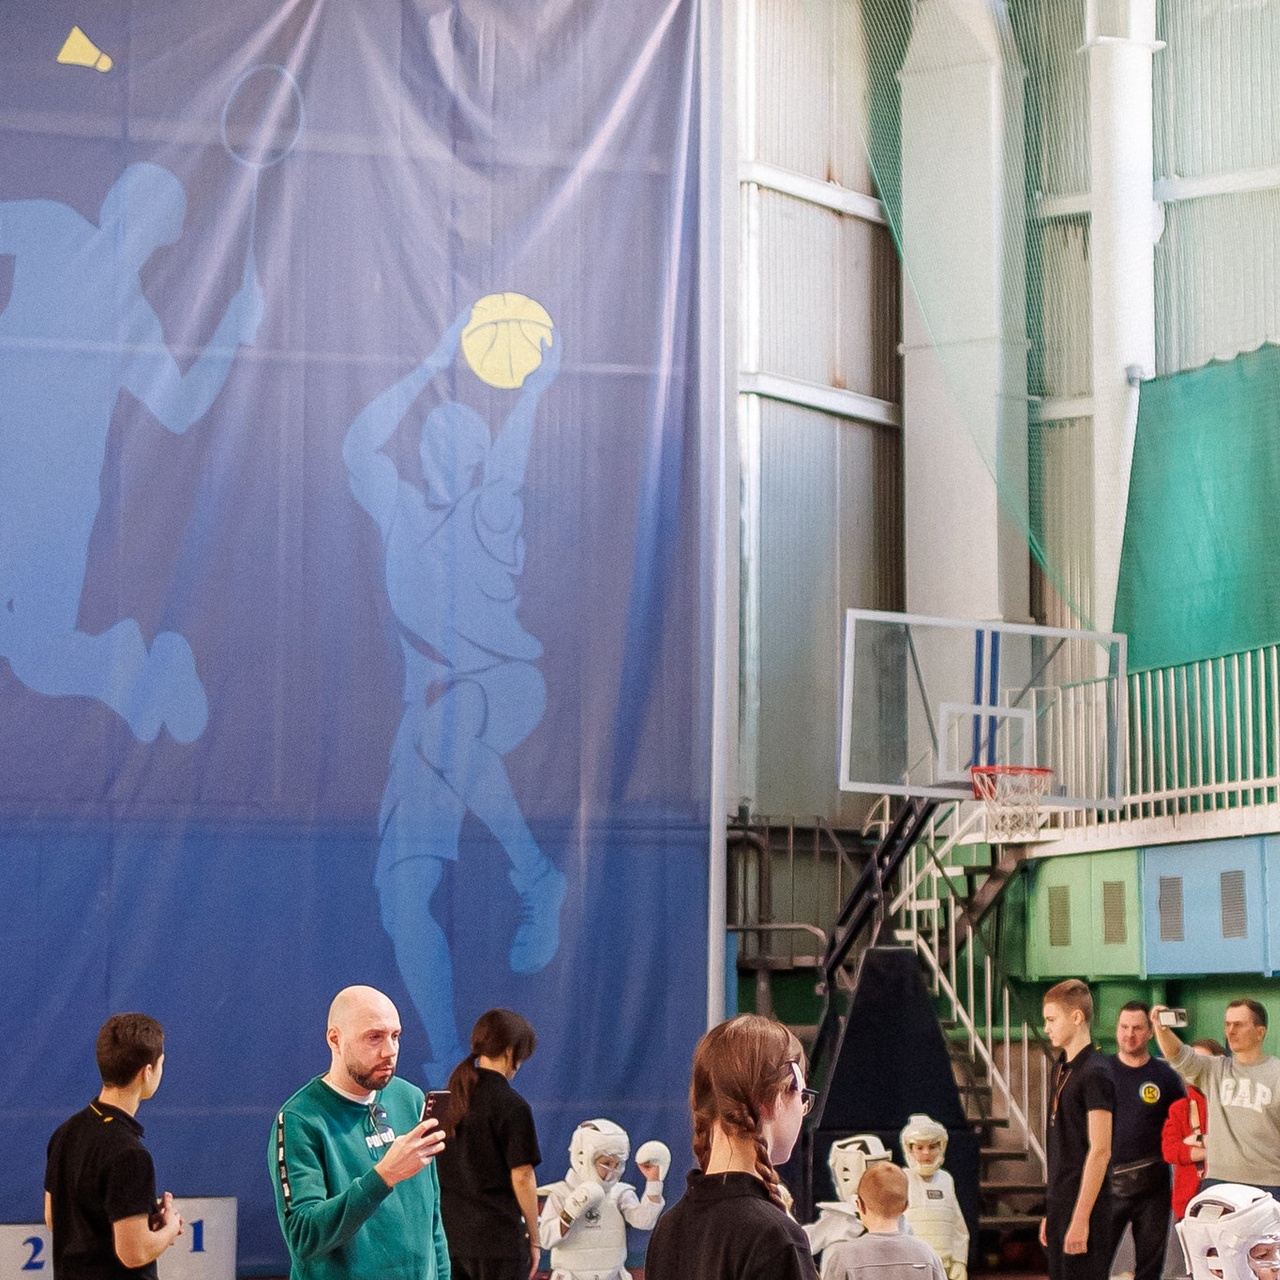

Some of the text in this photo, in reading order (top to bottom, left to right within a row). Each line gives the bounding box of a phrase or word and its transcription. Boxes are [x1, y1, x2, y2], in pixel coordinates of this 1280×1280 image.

[1221, 1077, 1273, 1113] GAP
[21, 1236, 46, 1271] 2
[189, 1219, 206, 1253] 1
